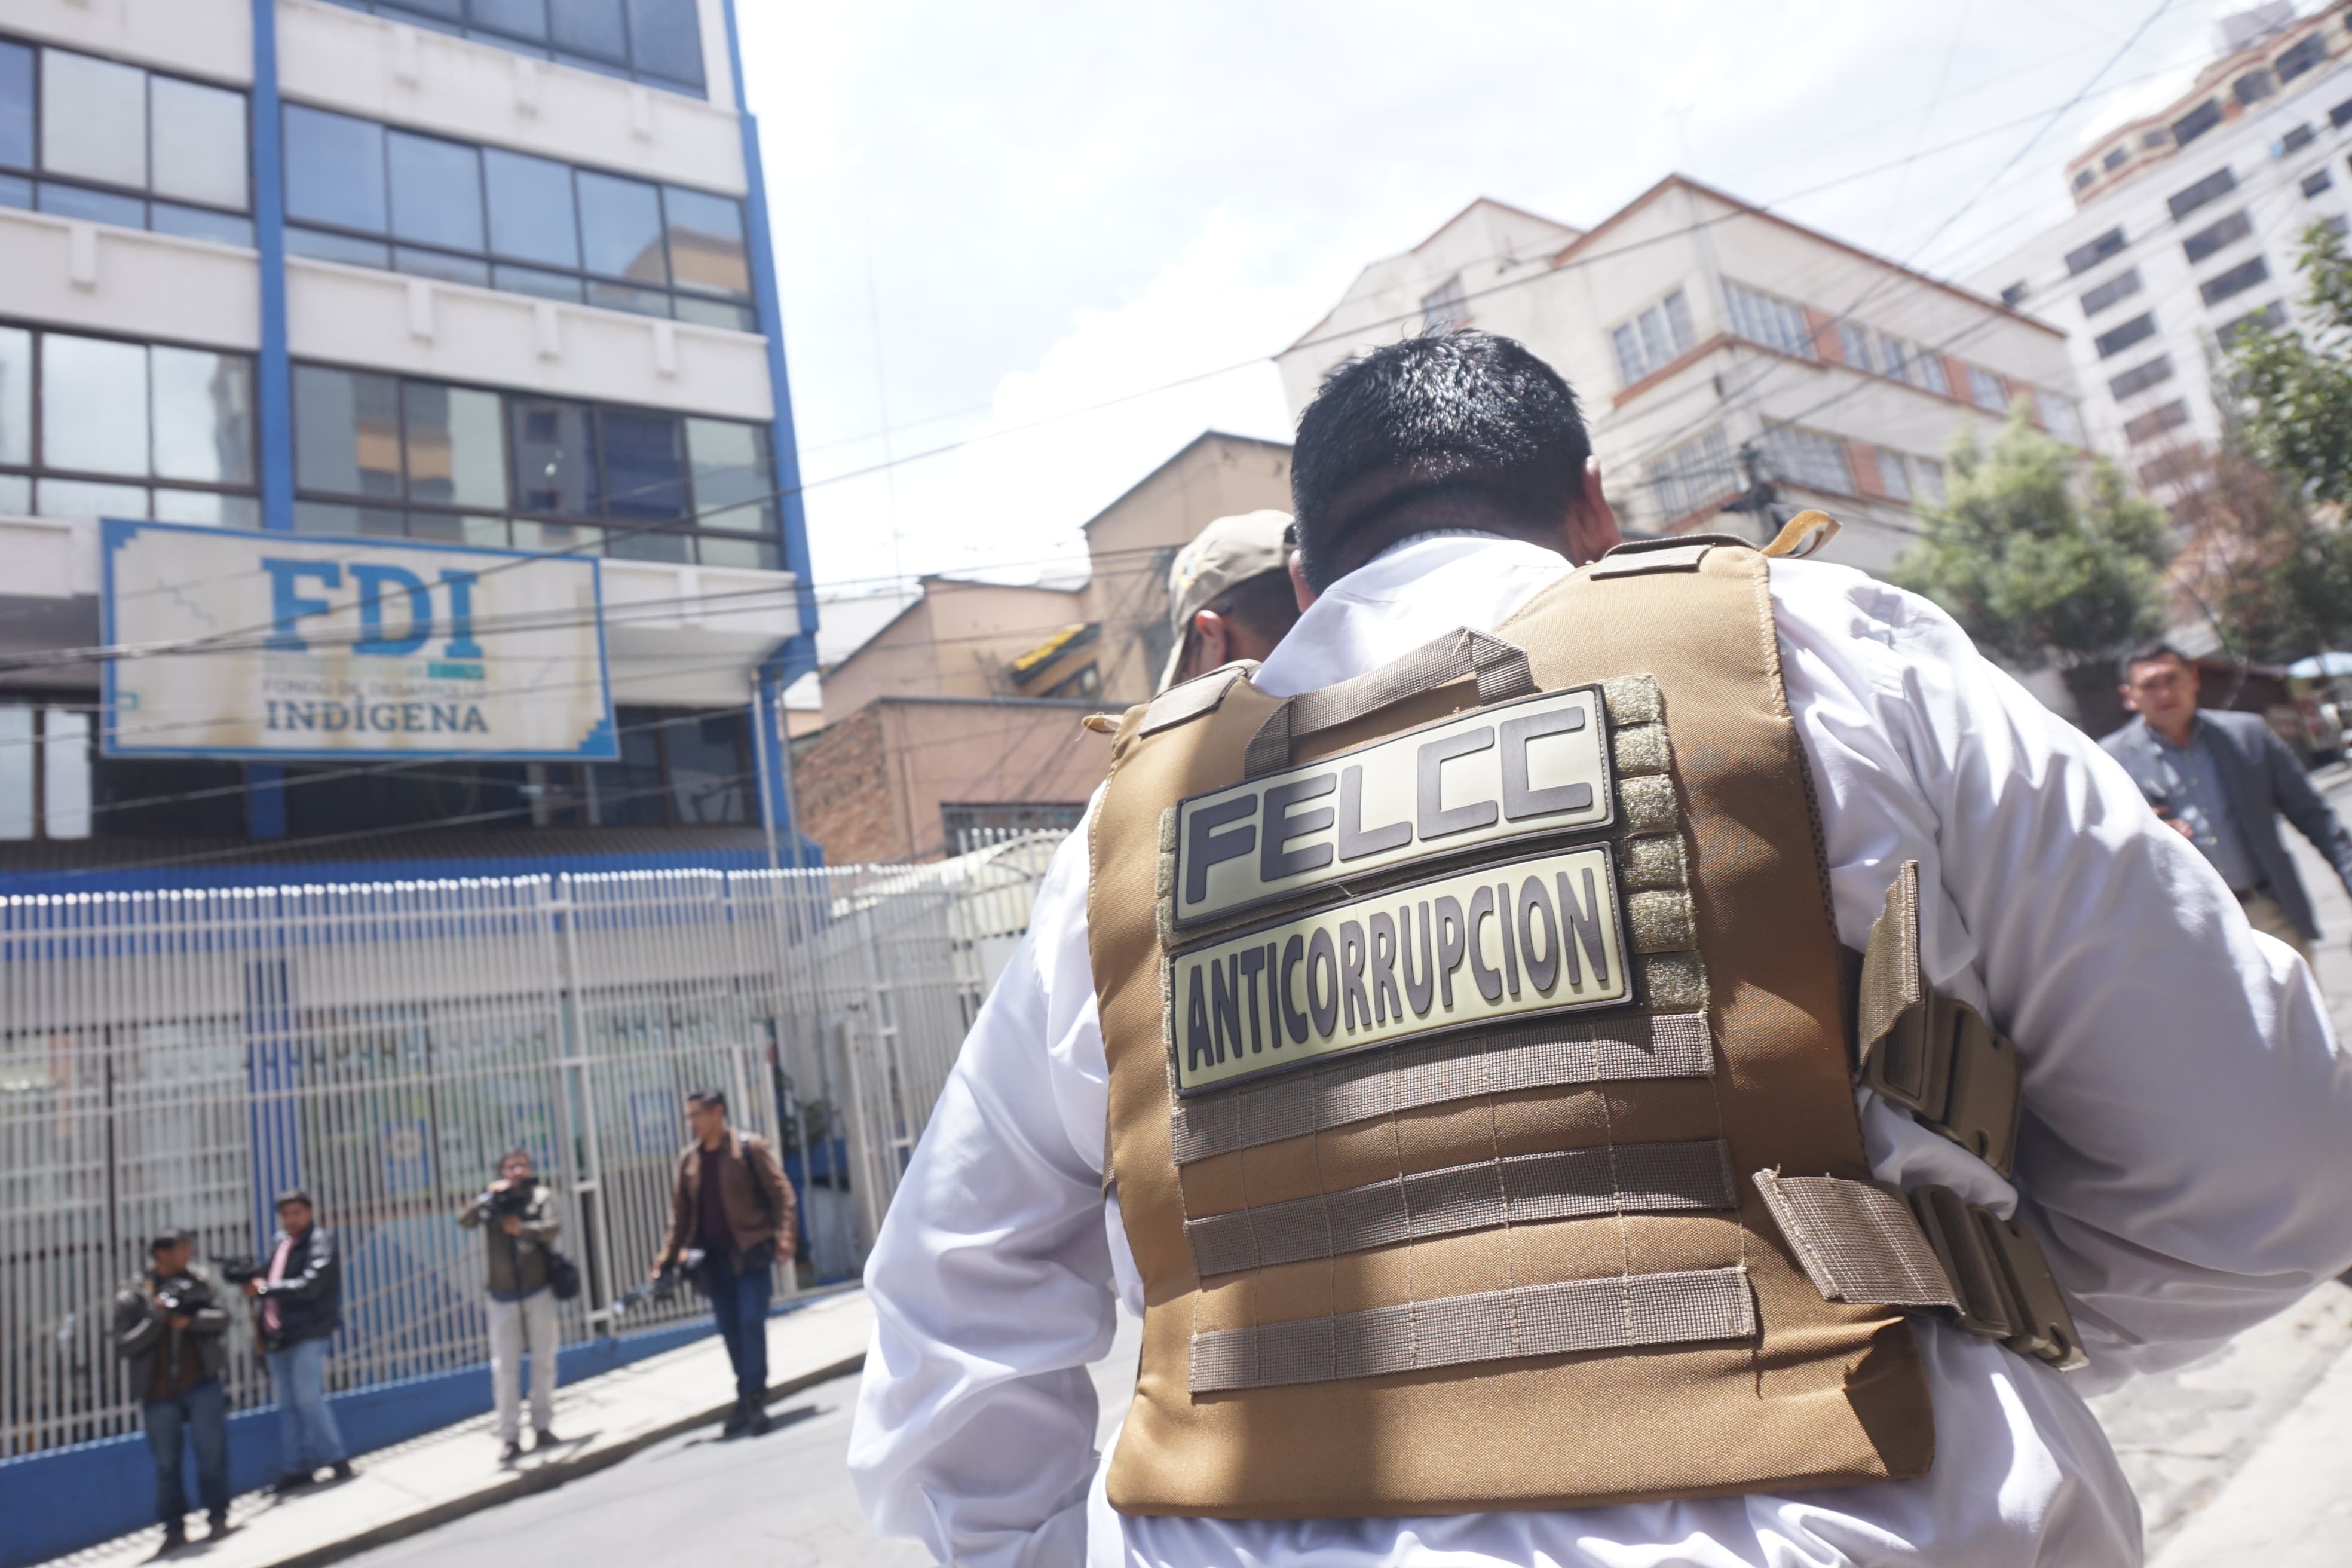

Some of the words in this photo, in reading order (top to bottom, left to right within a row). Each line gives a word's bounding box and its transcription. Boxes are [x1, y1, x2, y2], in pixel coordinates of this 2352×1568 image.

[261, 558, 483, 658] FDI
[265, 694, 489, 734] INDÍGENA
[1186, 706, 1592, 904] FELCC
[1187, 867, 1608, 1071] ANTICORRUPCION
